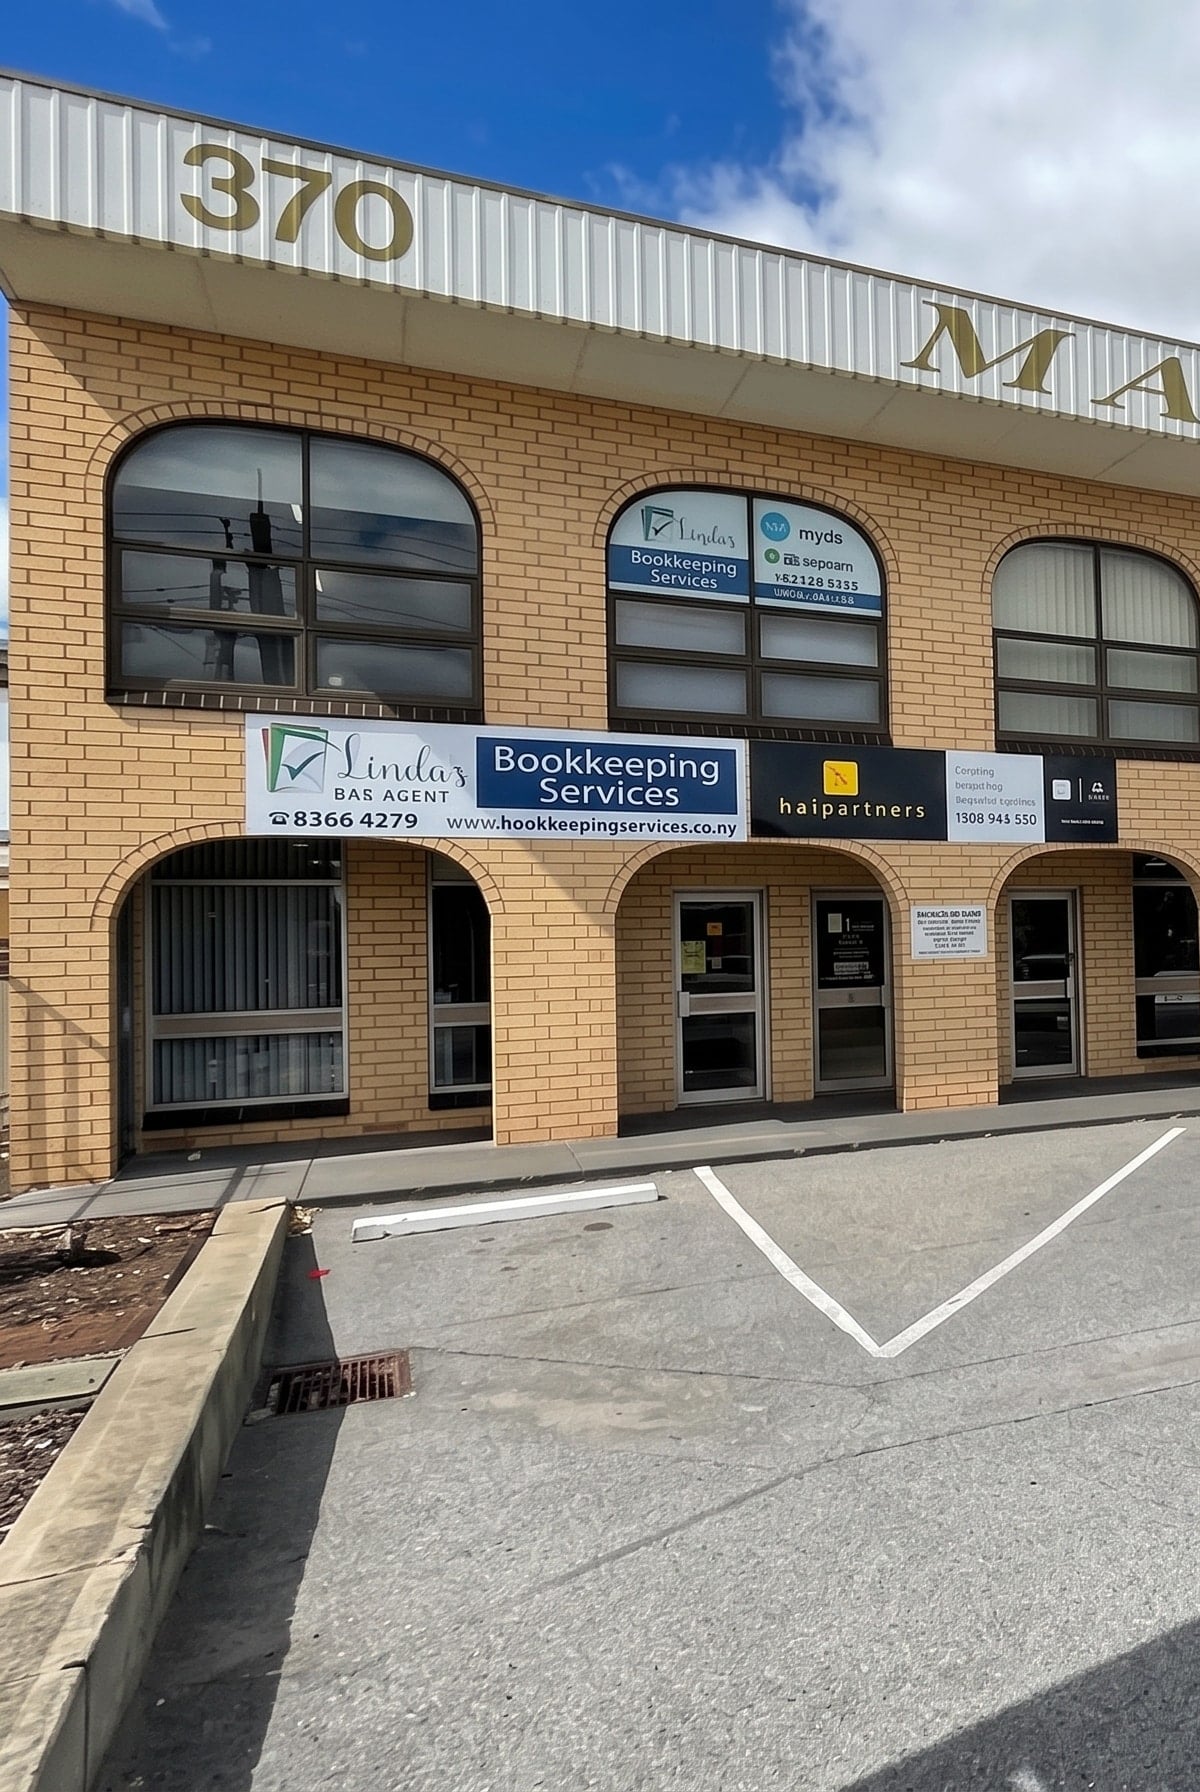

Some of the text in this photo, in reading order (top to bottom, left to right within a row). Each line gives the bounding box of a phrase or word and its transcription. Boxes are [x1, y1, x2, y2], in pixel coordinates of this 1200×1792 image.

[180, 142, 414, 262] 370
[800, 528, 843, 545] myds
[631, 550, 737, 577] Bookkeeping
[650, 569, 718, 590] Services
[493, 745, 721, 787] Bookkeeping
[334, 787, 450, 803] BAS AGENT
[539, 778, 680, 807] Services
[293, 810, 419, 830] 8366 4279
[780, 797, 926, 820] haipartners
[1015, 813, 1037, 826] 550
[446, 814, 738, 838] www.hookkeepingservices.co.ny
